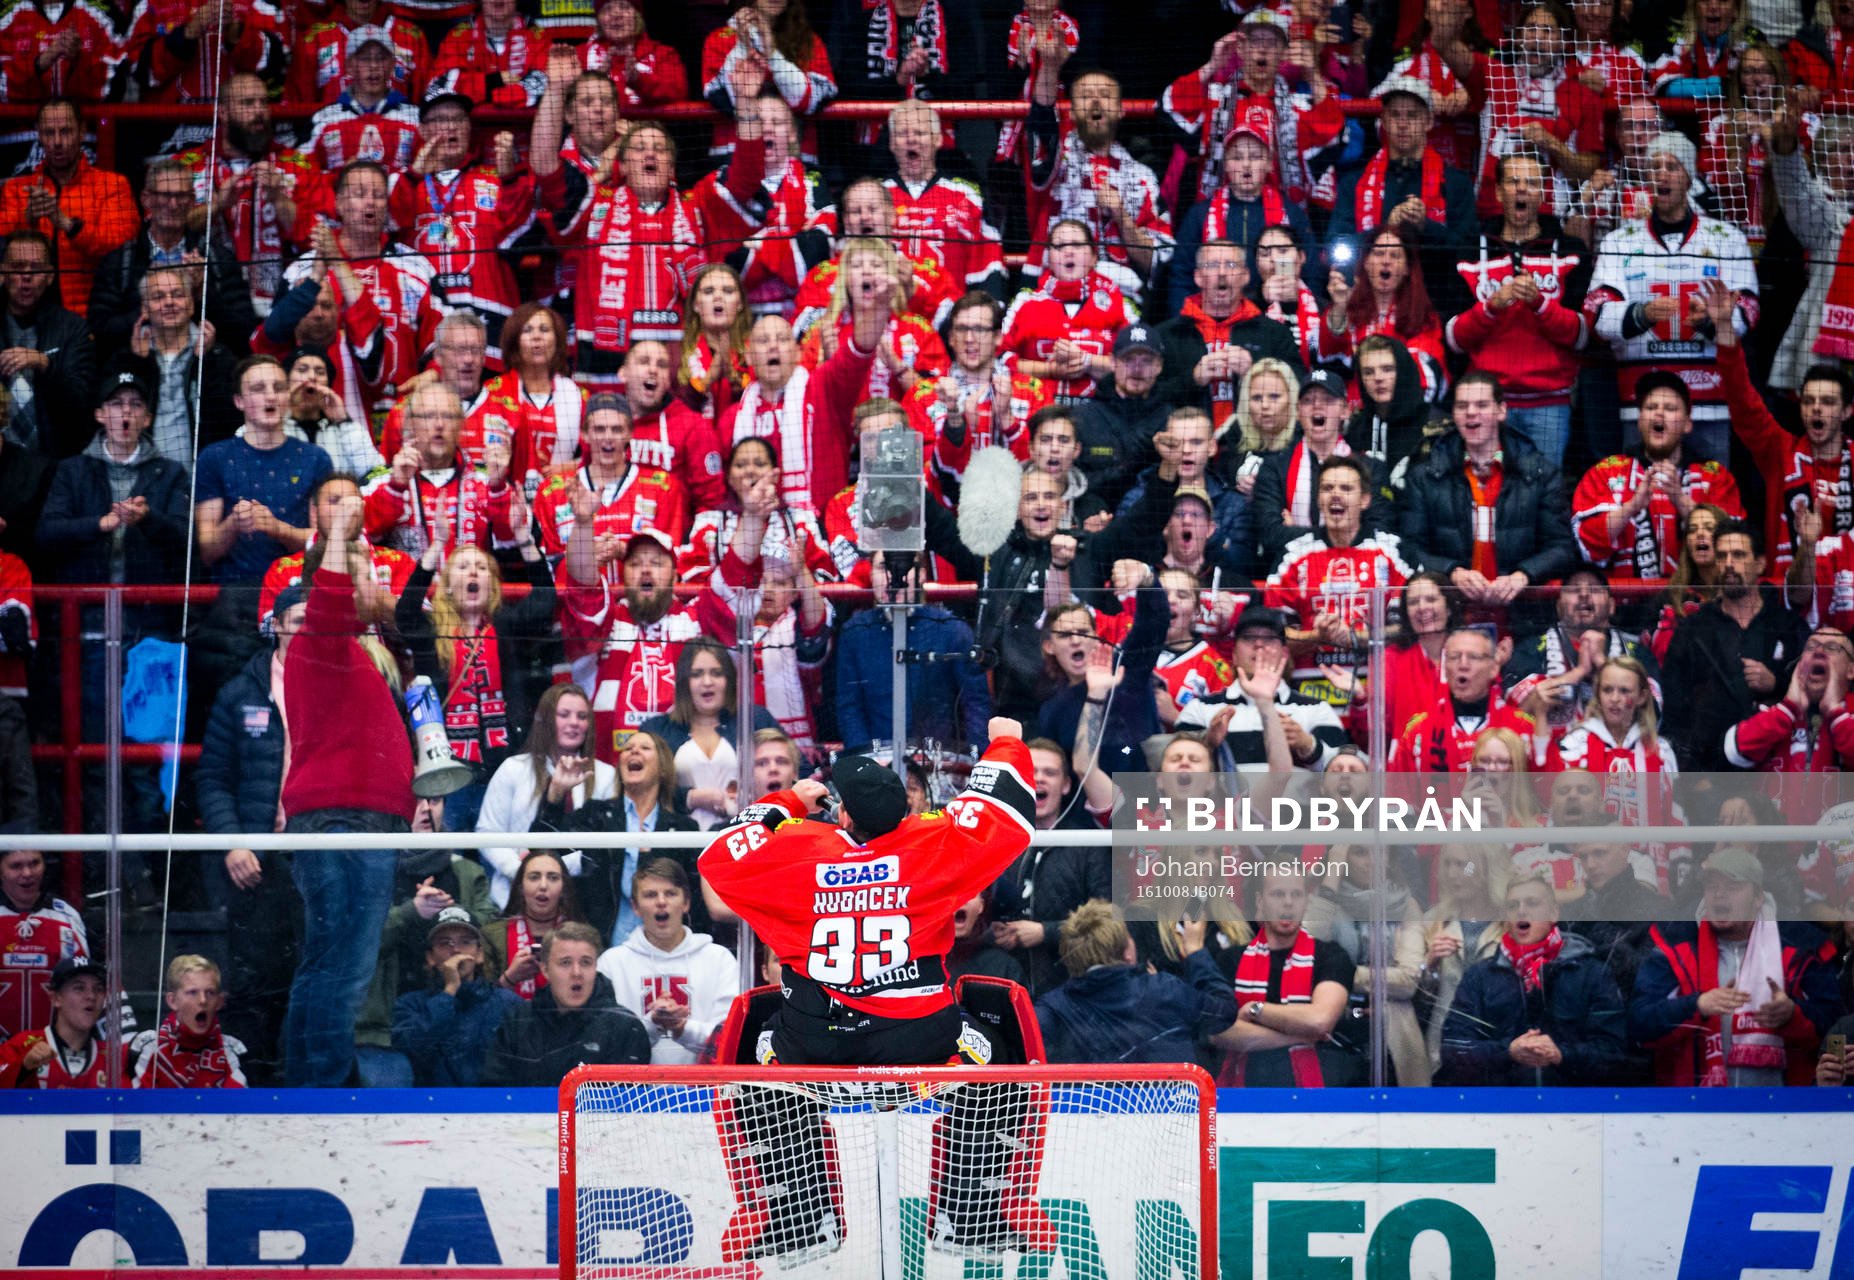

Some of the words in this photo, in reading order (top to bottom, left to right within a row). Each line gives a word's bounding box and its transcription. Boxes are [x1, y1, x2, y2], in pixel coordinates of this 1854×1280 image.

[824, 863, 890, 887] ÖBAB
[813, 885, 912, 915] HUDACEK
[807, 914, 912, 985] 33
